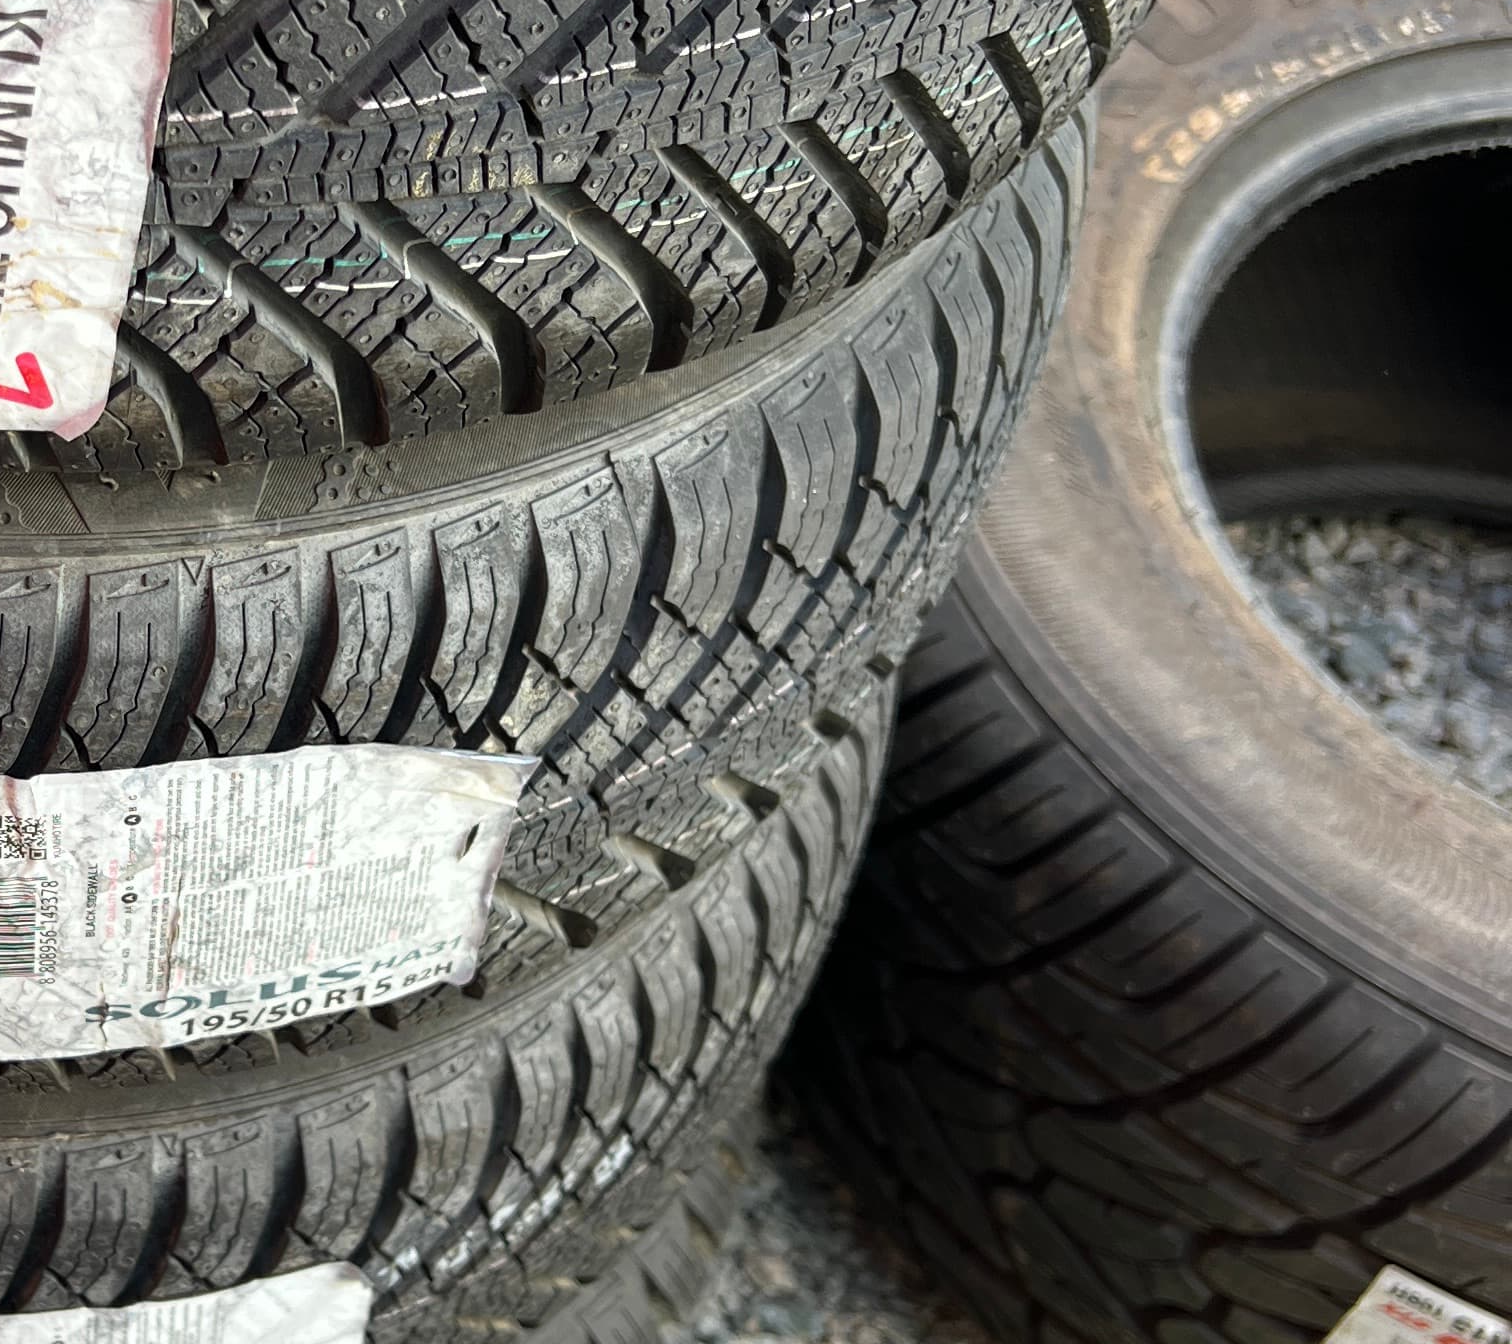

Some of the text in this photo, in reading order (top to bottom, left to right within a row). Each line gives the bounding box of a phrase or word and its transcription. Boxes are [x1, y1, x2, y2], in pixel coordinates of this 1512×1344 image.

[40, 880, 58, 923] 145378
[84, 863, 98, 937] BLACK SIDEWALL
[40, 930, 57, 972] 808956
[85, 932, 466, 1026] SOLUS HA31
[179, 959, 455, 1037] 195/50 R15 82H
